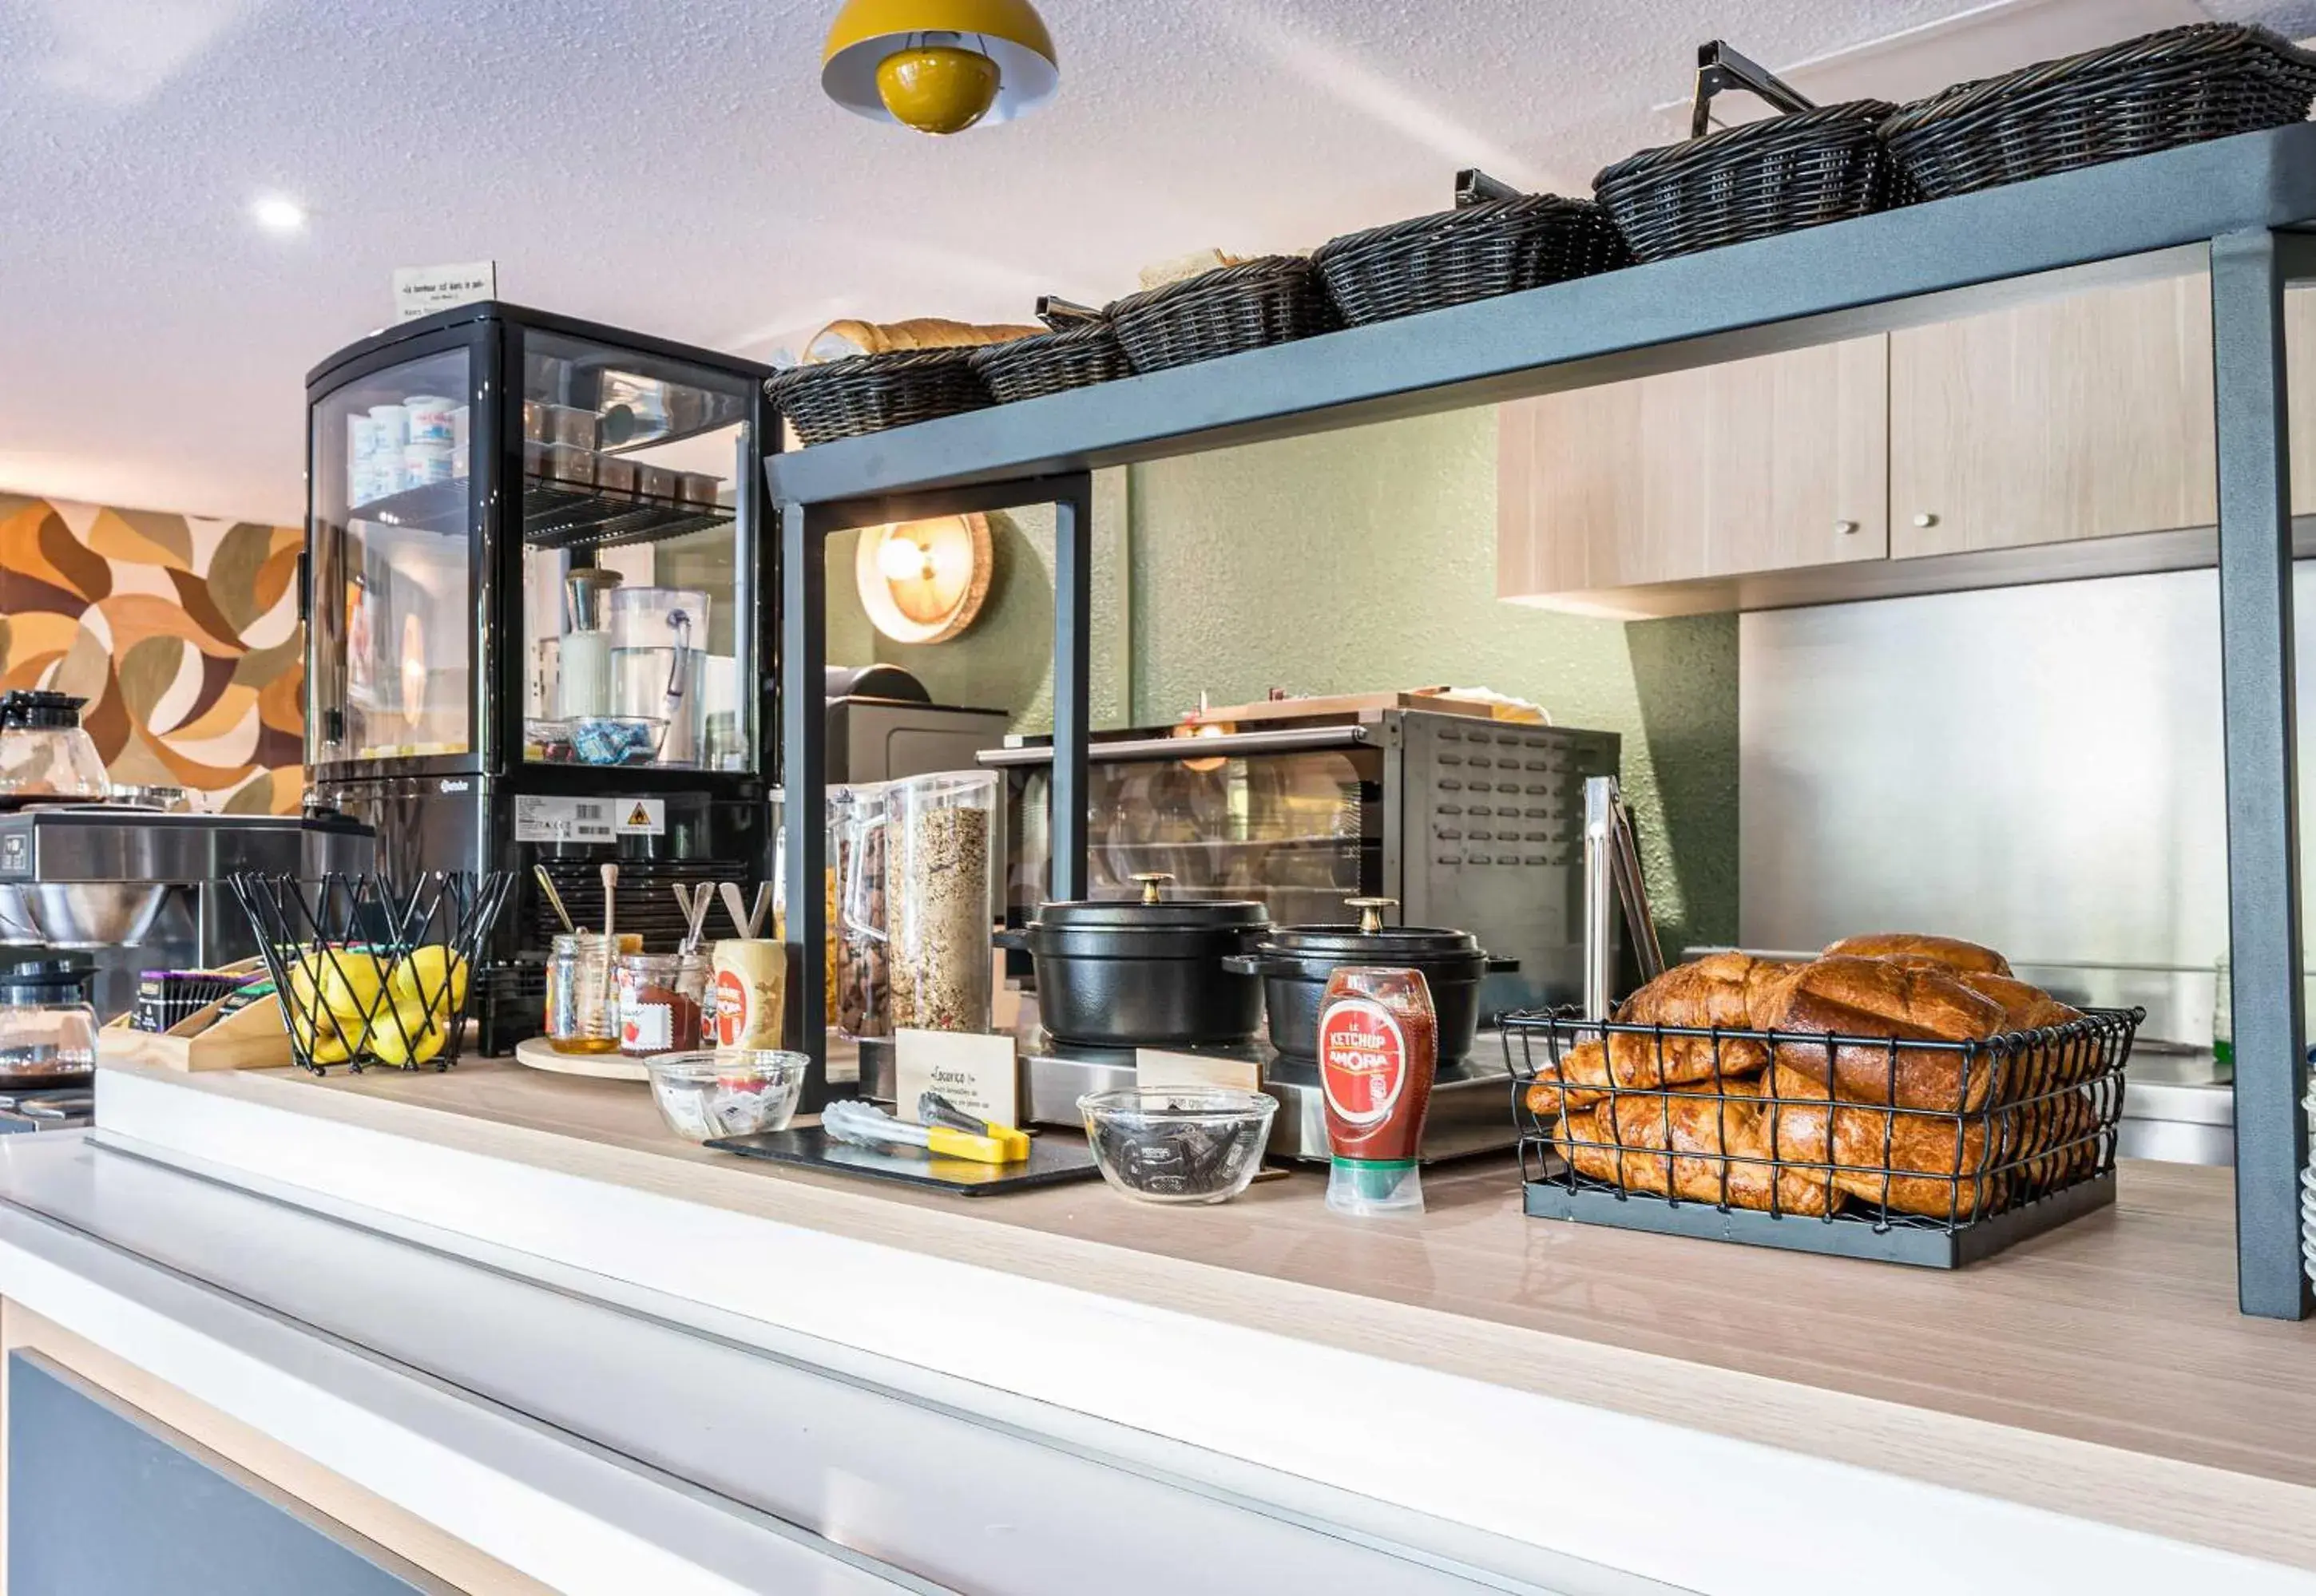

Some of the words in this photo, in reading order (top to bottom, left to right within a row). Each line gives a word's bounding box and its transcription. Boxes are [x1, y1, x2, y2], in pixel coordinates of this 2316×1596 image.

[1348, 1023, 1359, 1032] LE
[1330, 1032, 1386, 1049] KETCHUP
[1329, 1051, 1389, 1071] AMORA
